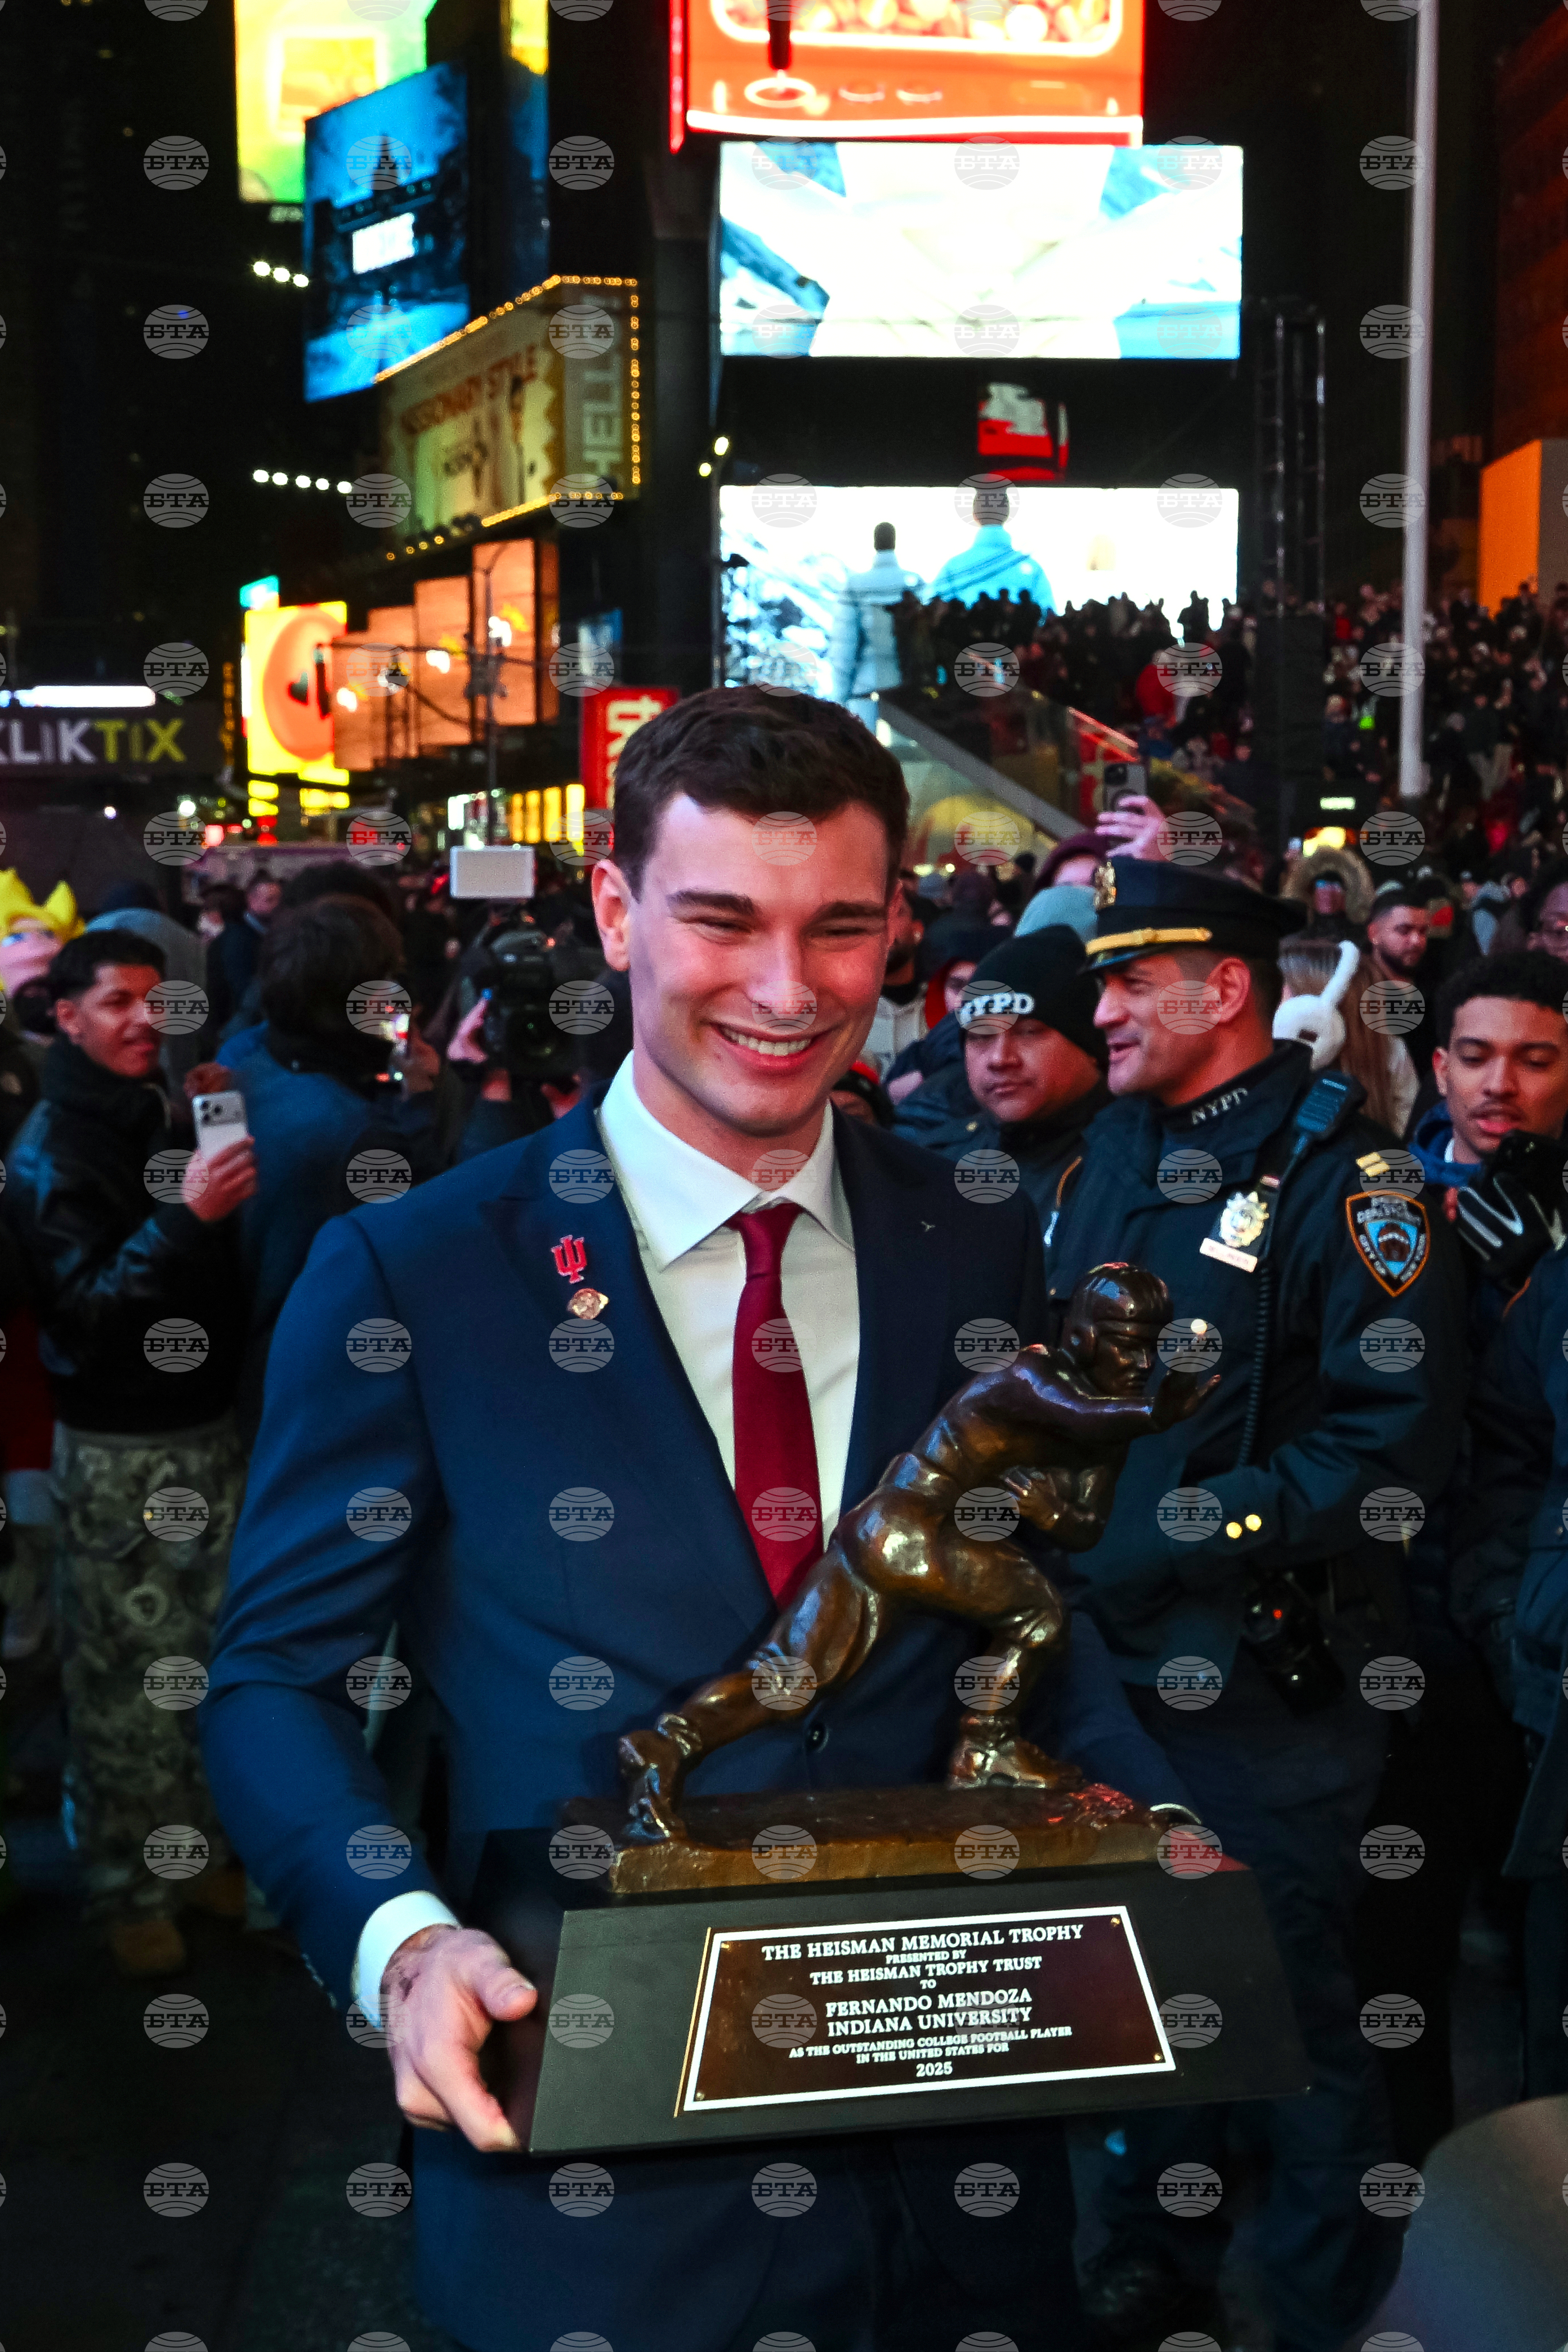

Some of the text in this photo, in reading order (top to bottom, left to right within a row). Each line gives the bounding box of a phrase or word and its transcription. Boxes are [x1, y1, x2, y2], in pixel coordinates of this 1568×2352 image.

[0, 717, 187, 764] LIKTIX
[761, 1924, 1084, 1961] THE HEISMAN MEMORIAL TROPHY
[886, 1949, 967, 1965] PRESENTED BY
[810, 1956, 1042, 1985] THE HEISMAN TROPHY TRUST
[919, 1979, 937, 1989] TO
[825, 1988, 1033, 2018] FERNANDO MENDOZA
[827, 2006, 1033, 2037] INDIANA UNIVERSITY
[788, 2026, 1073, 2059] AS THE OUTSTANDING COLLEGE FOOTBALL PLAYER
[856, 2042, 1009, 2064] IN THE UNITED STATES FOR
[916, 2061, 953, 2078] 2025
